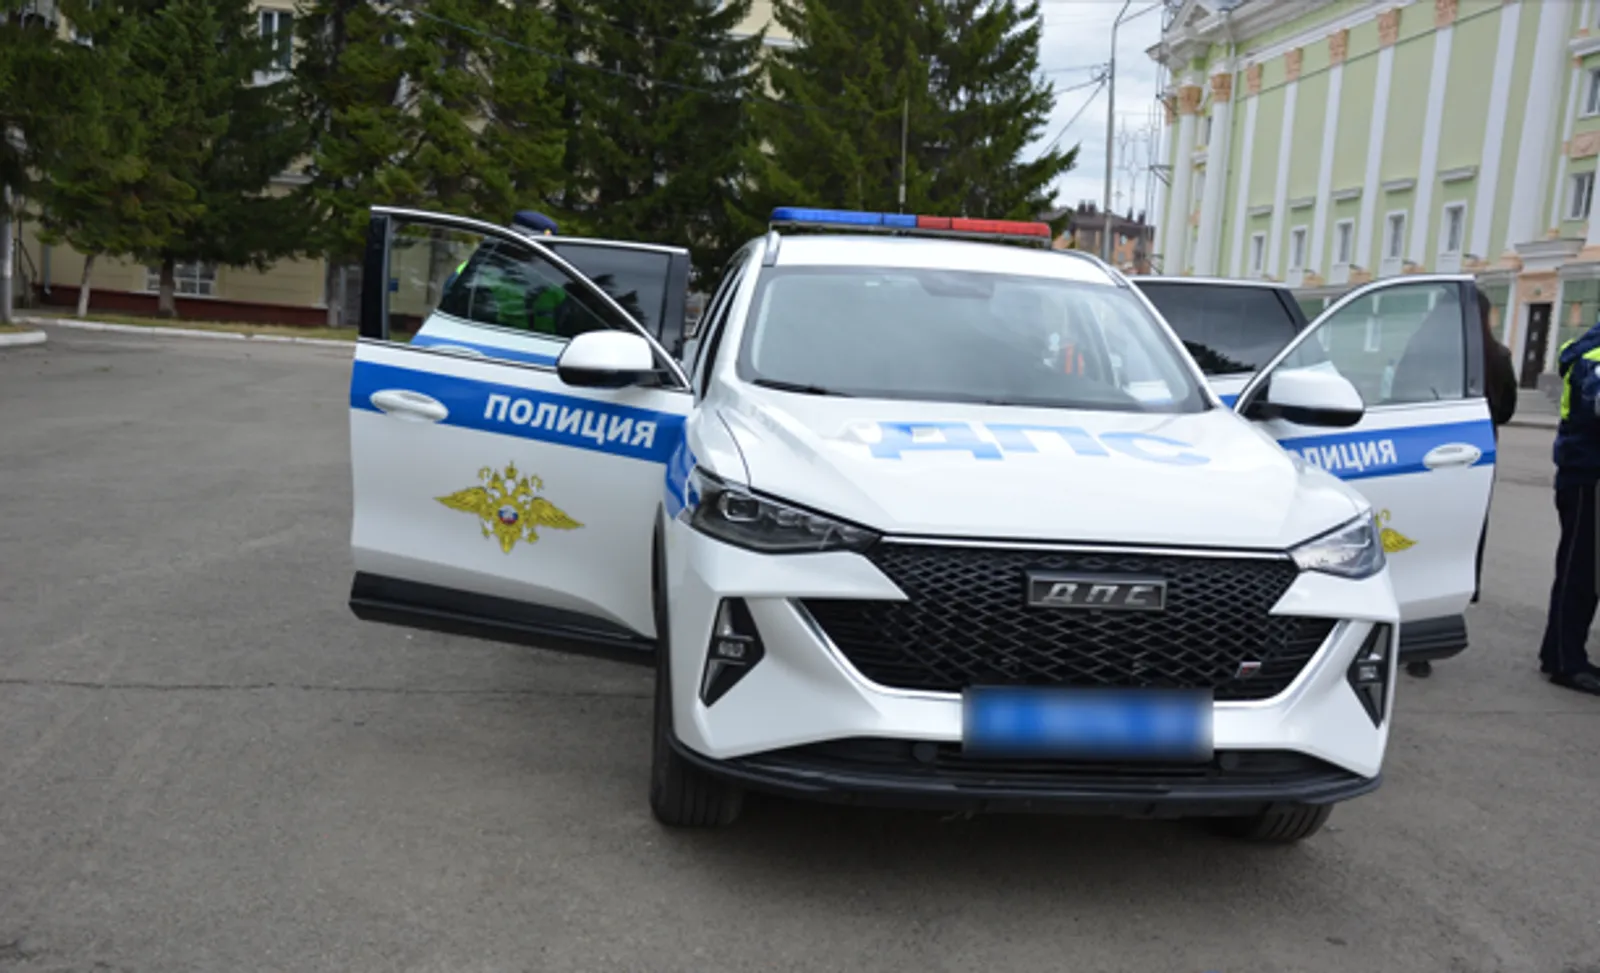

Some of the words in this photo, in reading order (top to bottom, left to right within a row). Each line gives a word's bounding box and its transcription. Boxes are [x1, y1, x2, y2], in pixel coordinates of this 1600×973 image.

[484, 393, 657, 449] ПОЛИЦИЯ
[869, 420, 1212, 466] ДПС
[1287, 438, 1398, 472] ЛИЦИЯ
[1042, 582, 1155, 605] ДПС
